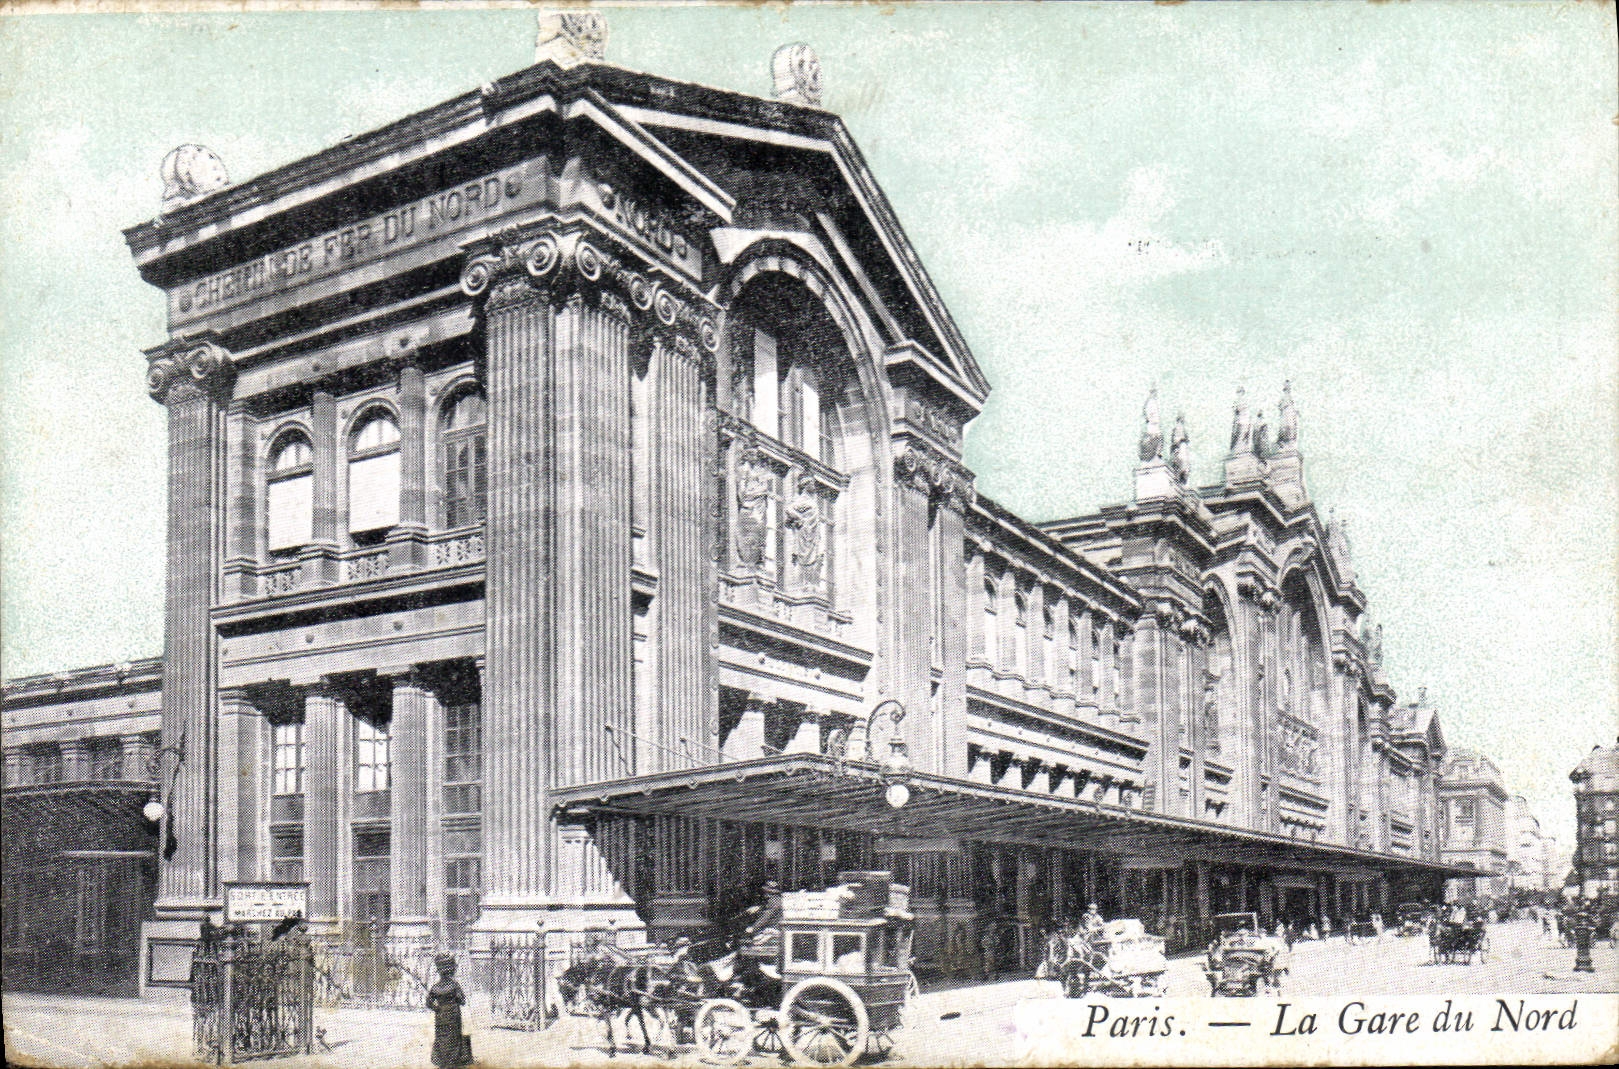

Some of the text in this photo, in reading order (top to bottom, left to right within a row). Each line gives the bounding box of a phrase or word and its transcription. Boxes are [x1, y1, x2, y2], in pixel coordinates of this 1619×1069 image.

[195, 176, 501, 311] CHEMIN DE FER DU NORD
